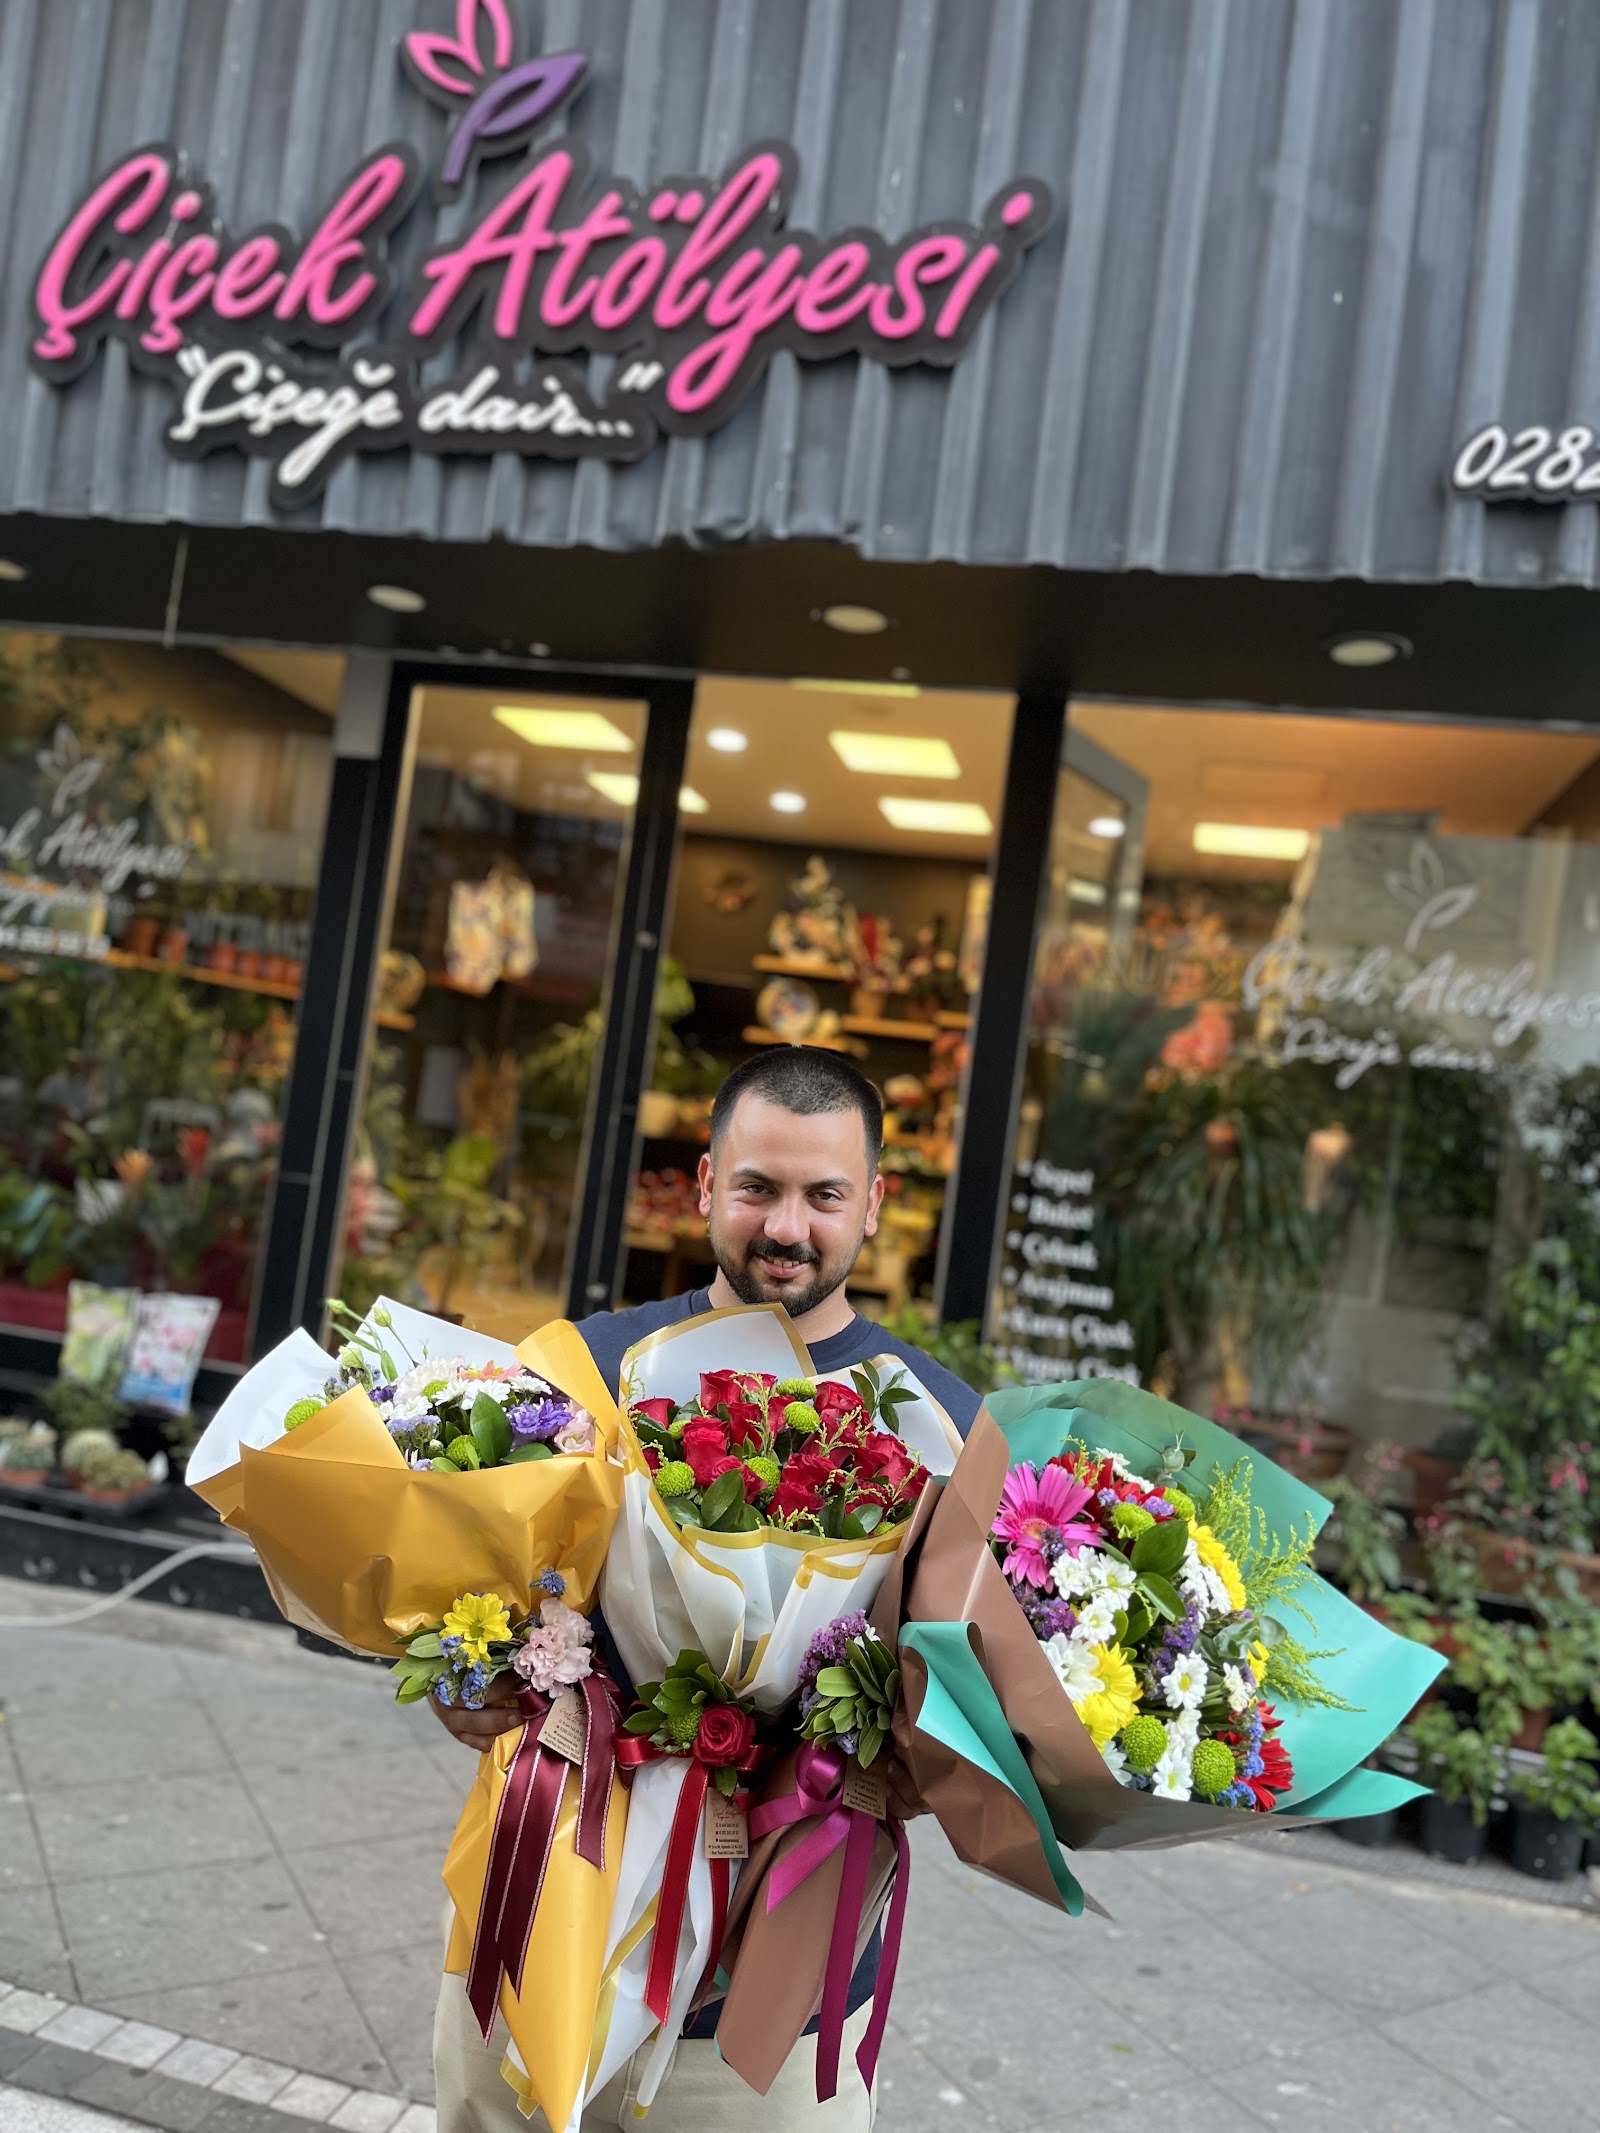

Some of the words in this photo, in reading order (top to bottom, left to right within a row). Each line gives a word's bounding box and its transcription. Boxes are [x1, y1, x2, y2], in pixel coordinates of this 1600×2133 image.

[36, 153, 403, 358] Çiçek
[409, 151, 1033, 412] Atölyesi
[1393, 950, 1600, 1048] Atölyes
